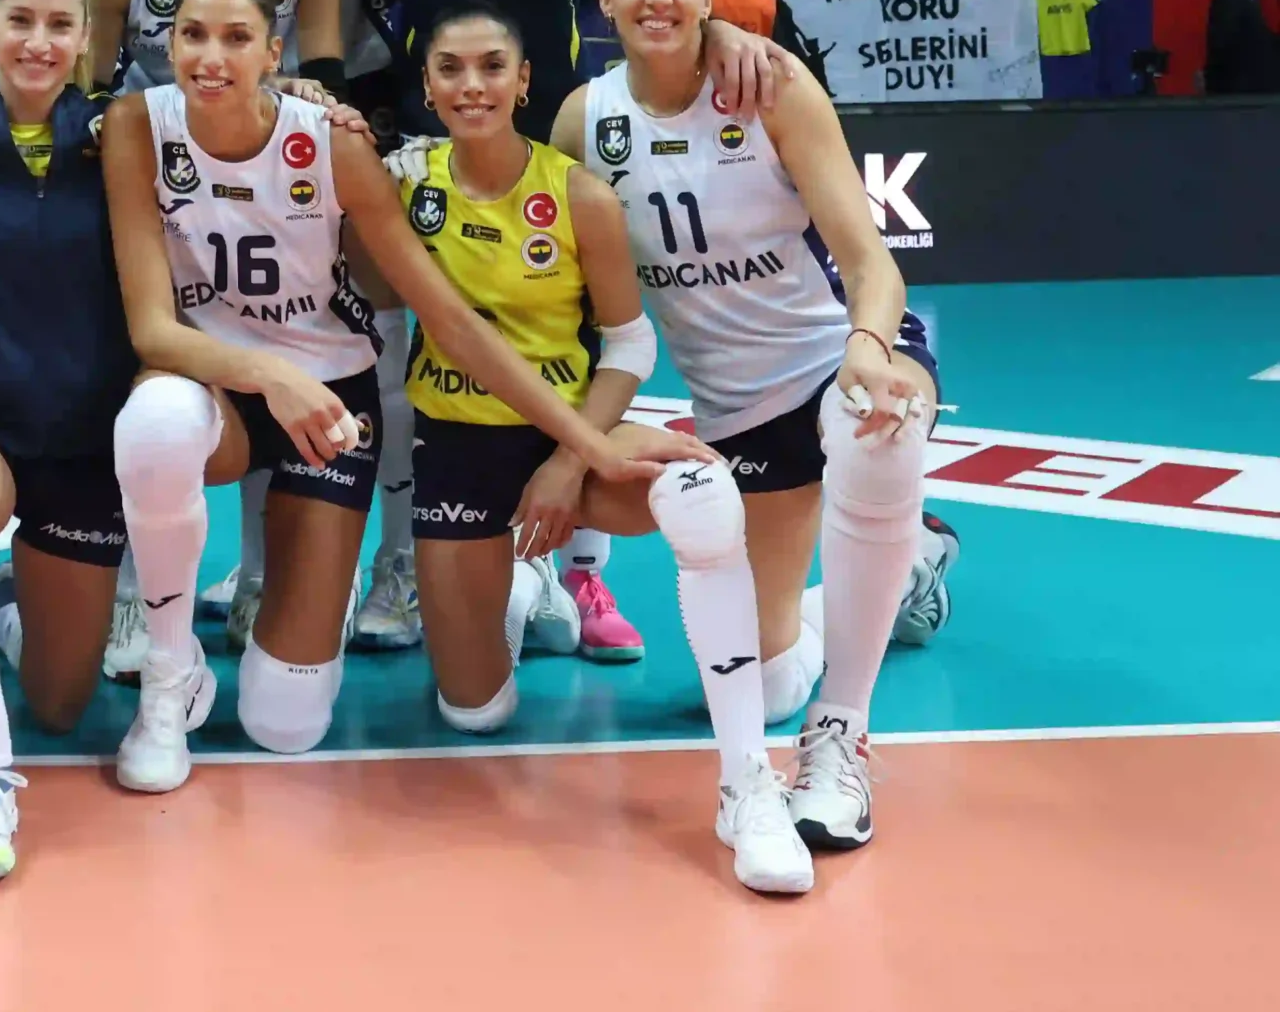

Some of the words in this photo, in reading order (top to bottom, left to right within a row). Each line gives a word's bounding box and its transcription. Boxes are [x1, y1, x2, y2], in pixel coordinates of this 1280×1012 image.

[885, 64, 954, 90] DUY!
[605, 119, 623, 129] CEV
[172, 145, 187, 155] CE
[423, 189, 439, 199] CEV
[863, 151, 933, 231] K
[647, 191, 708, 255] 11
[207, 232, 280, 297] 16
